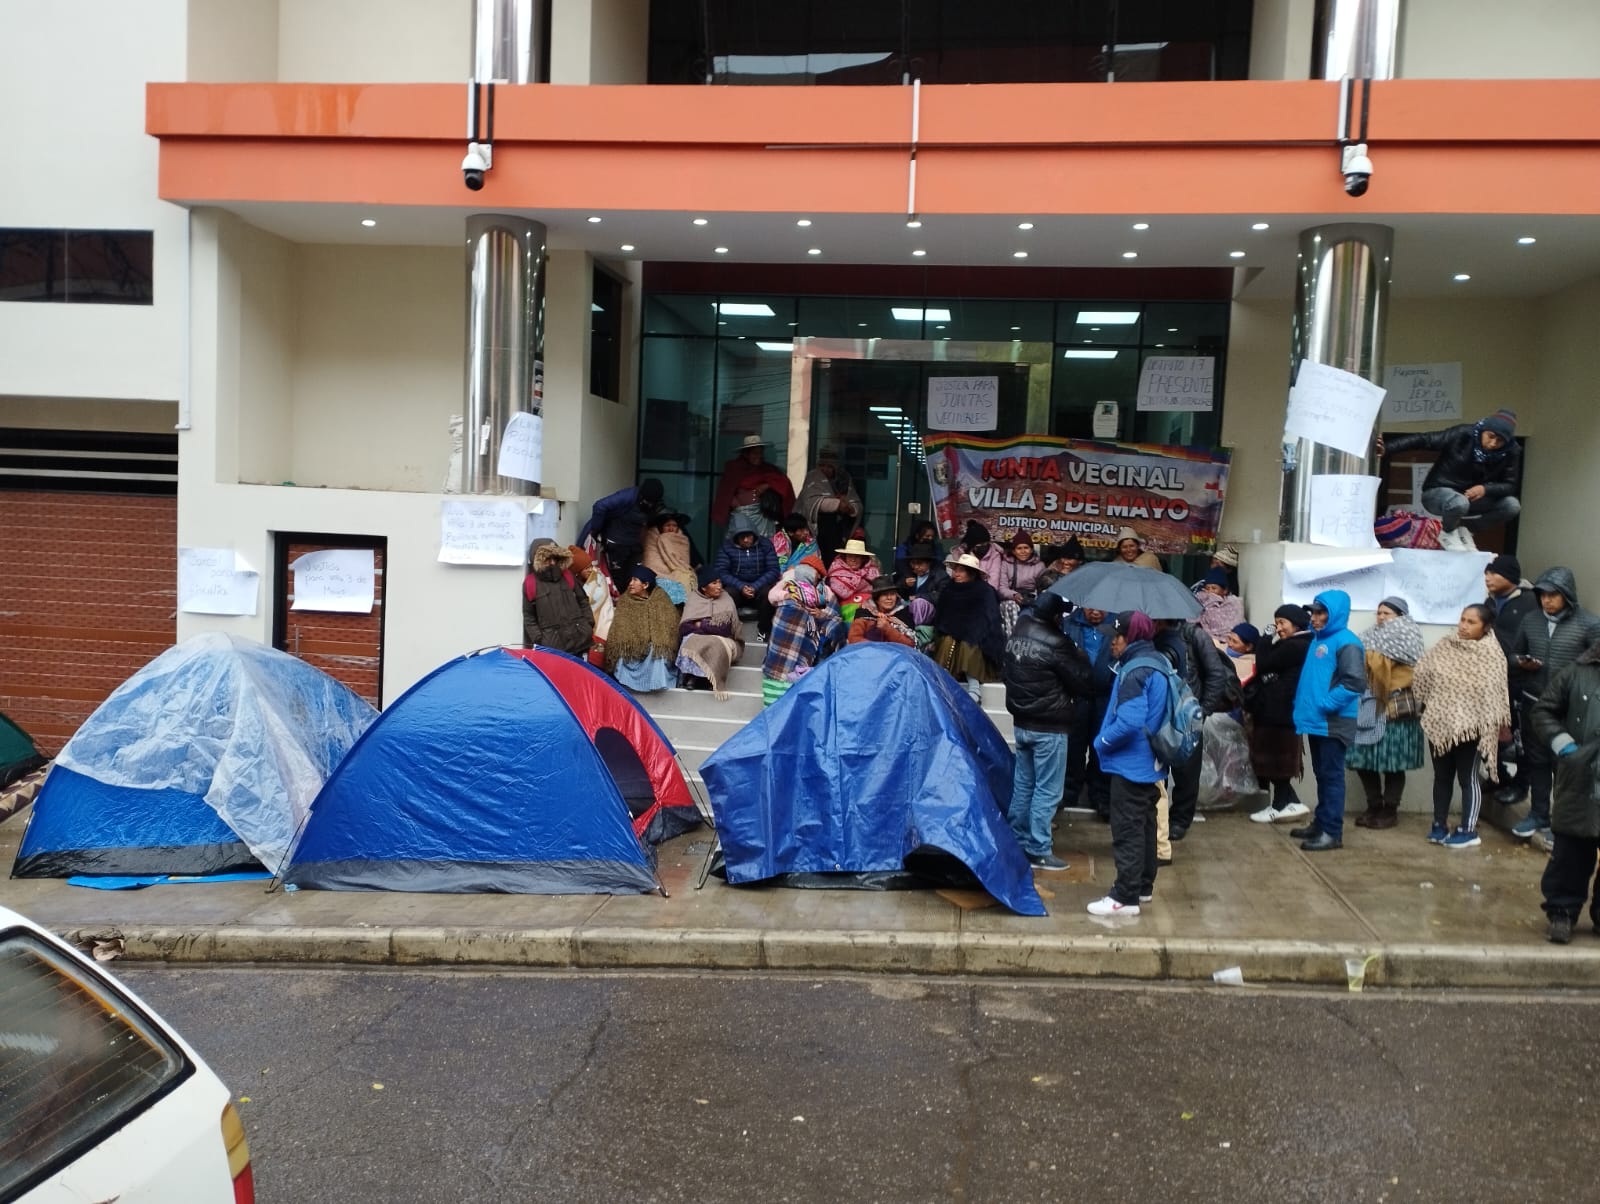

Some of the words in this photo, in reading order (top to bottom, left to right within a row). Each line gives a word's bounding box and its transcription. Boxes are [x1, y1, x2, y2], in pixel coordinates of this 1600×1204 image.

[1148, 373, 1214, 394] PRESENTE
[940, 392, 994, 408] JUNTAS
[1391, 399, 1457, 414] JUSTICIA
[982, 456, 1061, 481] JUNTA
[1068, 461, 1184, 490] VECINAL
[968, 487, 1036, 511] VILLA
[1043, 493, 1058, 512] 3
[1065, 492, 1099, 516] DE
[1106, 495, 1190, 521] MAYO
[999, 516, 1048, 530] DISTRITO
[1050, 519, 1118, 535] MUNICIPAL
